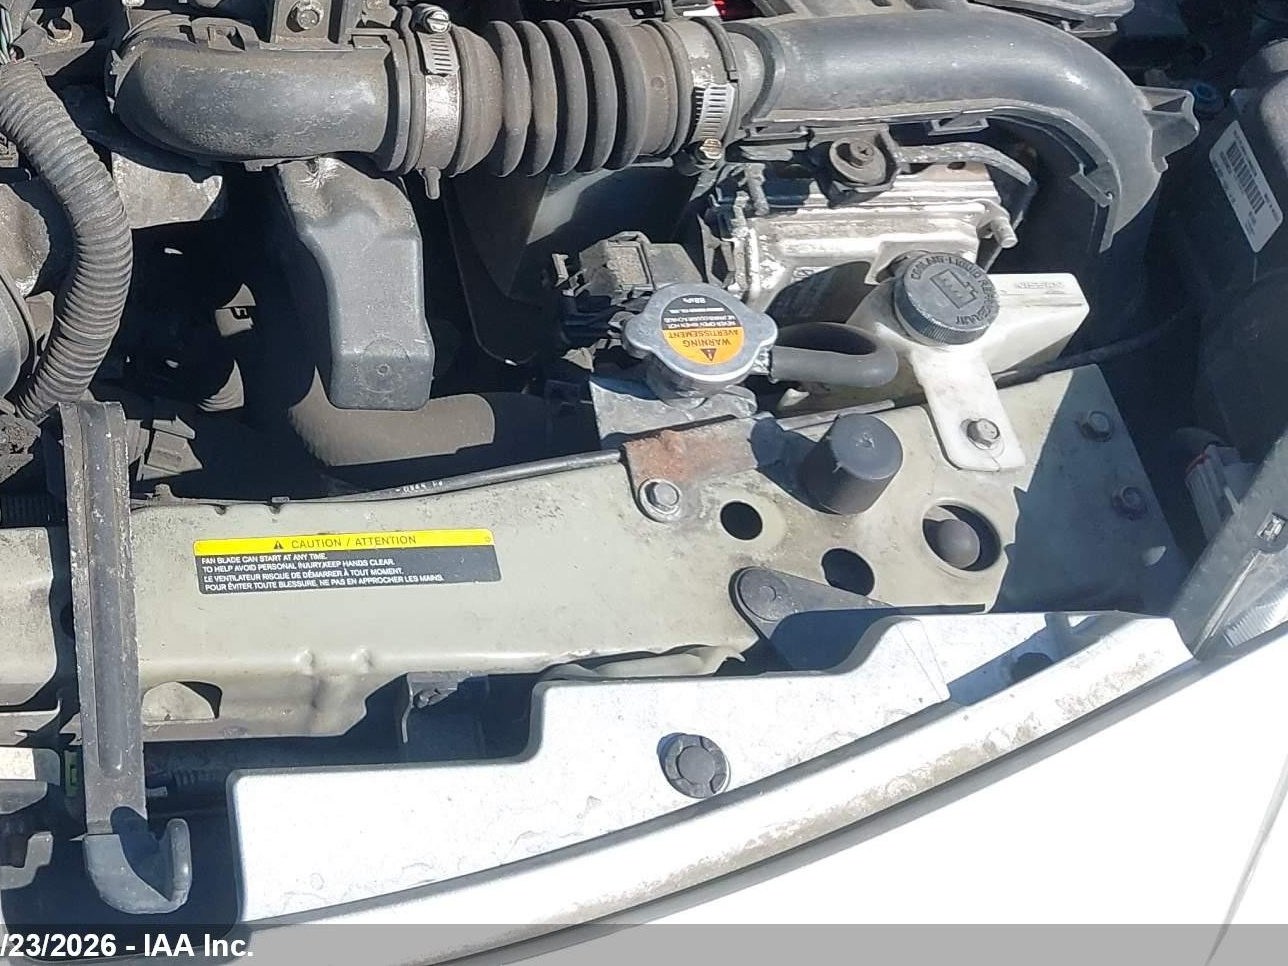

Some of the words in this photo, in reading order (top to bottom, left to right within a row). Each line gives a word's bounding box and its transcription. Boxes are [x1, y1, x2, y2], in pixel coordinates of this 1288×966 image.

[668, 329, 738, 339] AVERTISSEMENT
[682, 338, 732, 348] WARNING
[291, 538, 342, 549] CAUTION
[355, 535, 417, 547] ATTENTION
[201, 556, 216, 565] FAN
[217, 555, 241, 564] BLADE
[242, 554, 259, 563] CAN
[260, 554, 281, 562] START
[283, 553, 292, 561] AT
[293, 553, 308, 561] ANY
[202, 565, 213, 573] TO
[214, 564, 233, 573] HELP
[234, 564, 257, 572] AVOID
[258, 562, 297, 571] PERSONAL
[342, 559, 368, 567] HANDS
[204, 575, 213, 583] LE
[214, 574, 260, 583] VENTILATEUR
[262, 572, 289, 581] RISQUE
[291, 571, 301, 579] DE
[302, 569, 343, 579] DÉMARRER
[350, 568, 369, 576] TOUT
[205, 583, 226, 591] POUR
[253, 581, 278, 590] TOUTE
[319, 579, 330, 587] NE
[331, 578, 345, 586] PAS
[347, 577, 357, 585] EN
[358, 575, 404, 585] APPROCHER
[405, 575, 419, 583] LES
